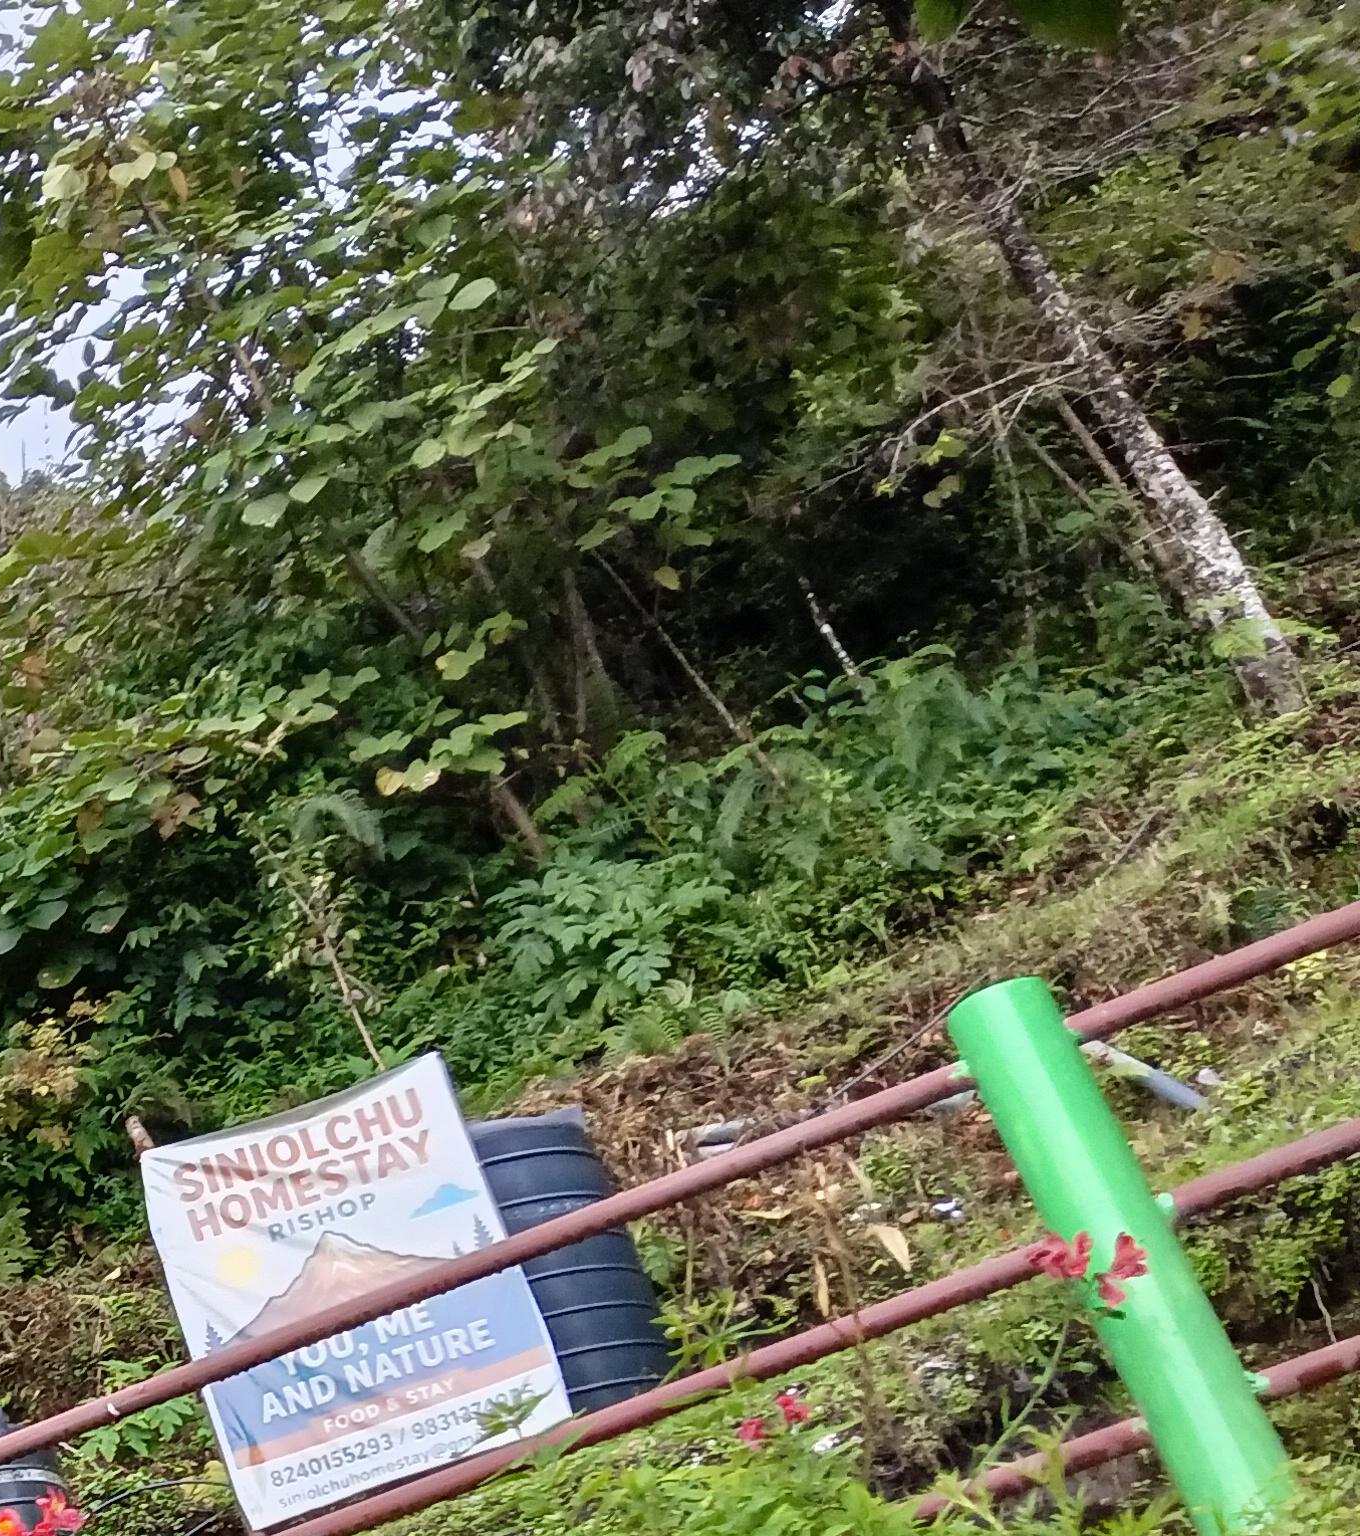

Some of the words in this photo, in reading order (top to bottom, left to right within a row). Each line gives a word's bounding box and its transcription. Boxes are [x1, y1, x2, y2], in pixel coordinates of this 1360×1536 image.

[173, 1088, 424, 1203] SINIOLCHU
[186, 1129, 431, 1242] HOMESTAY
[267, 1192, 376, 1242] RISHOP
[262, 1374, 336, 1425] AND
[343, 1318, 497, 1394] NATURE
[278, 1330, 369, 1377] YOU,
[373, 1299, 435, 1344] ME
[323, 1404, 380, 1434] FOOD
[387, 1397, 401, 1412] &
[406, 1377, 455, 1406] STAY
[270, 1432, 394, 1488] 8240155293
